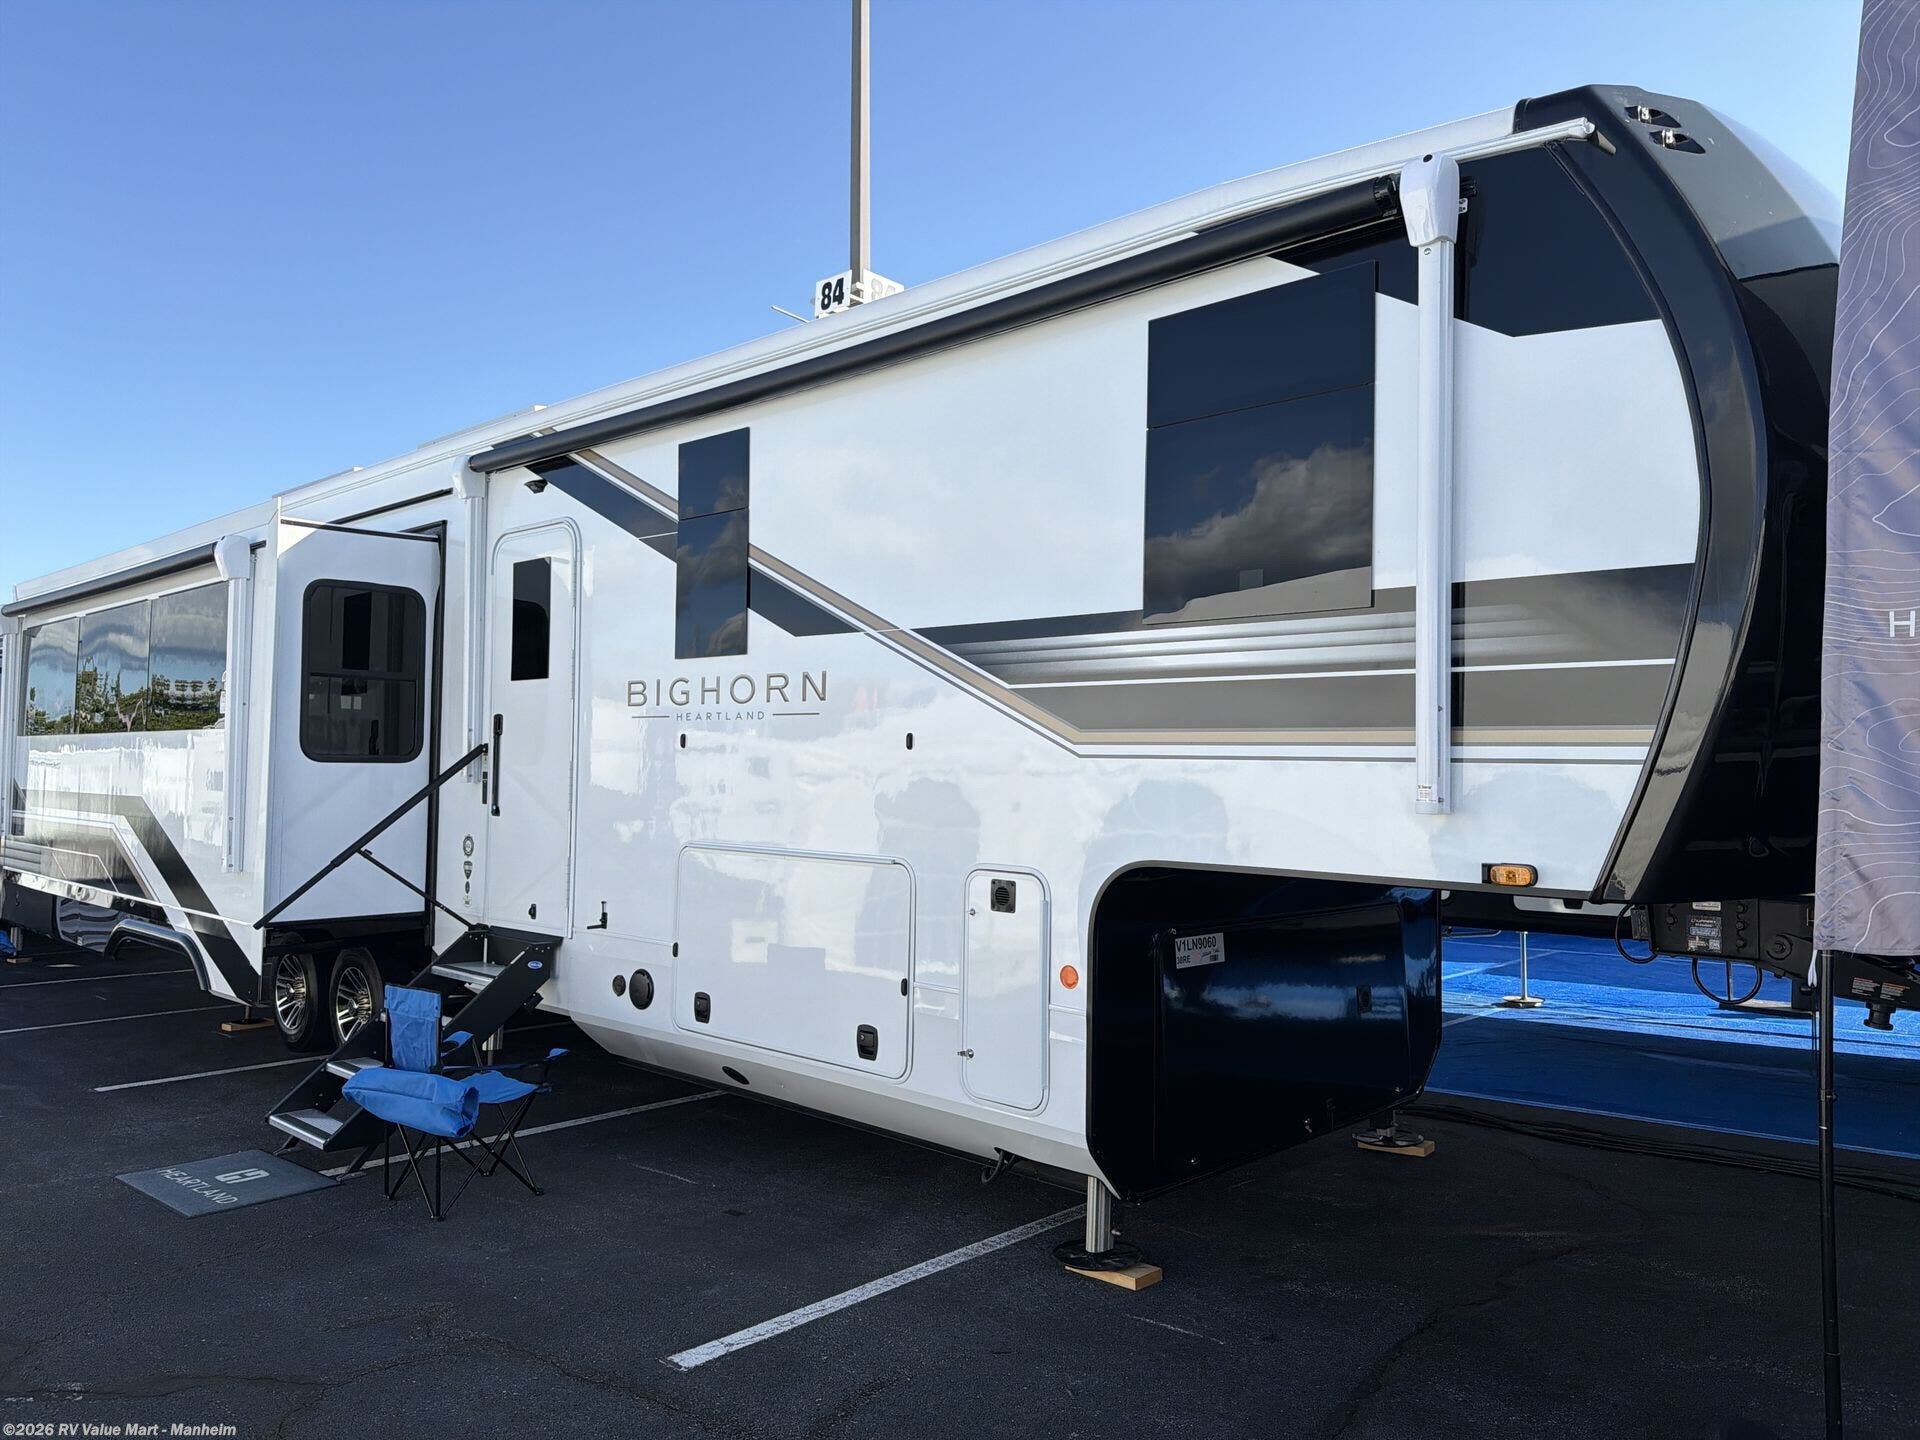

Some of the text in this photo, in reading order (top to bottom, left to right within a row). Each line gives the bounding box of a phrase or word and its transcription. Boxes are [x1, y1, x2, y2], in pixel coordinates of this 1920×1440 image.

[821, 277, 844, 311] 84
[1889, 610, 1916, 638] H
[627, 671, 828, 707] BIGHORN
[676, 711, 766, 722] HEARTLAND
[1176, 936, 1217, 952] V1LN9060
[159, 1168, 239, 1204] HEARTLAND
